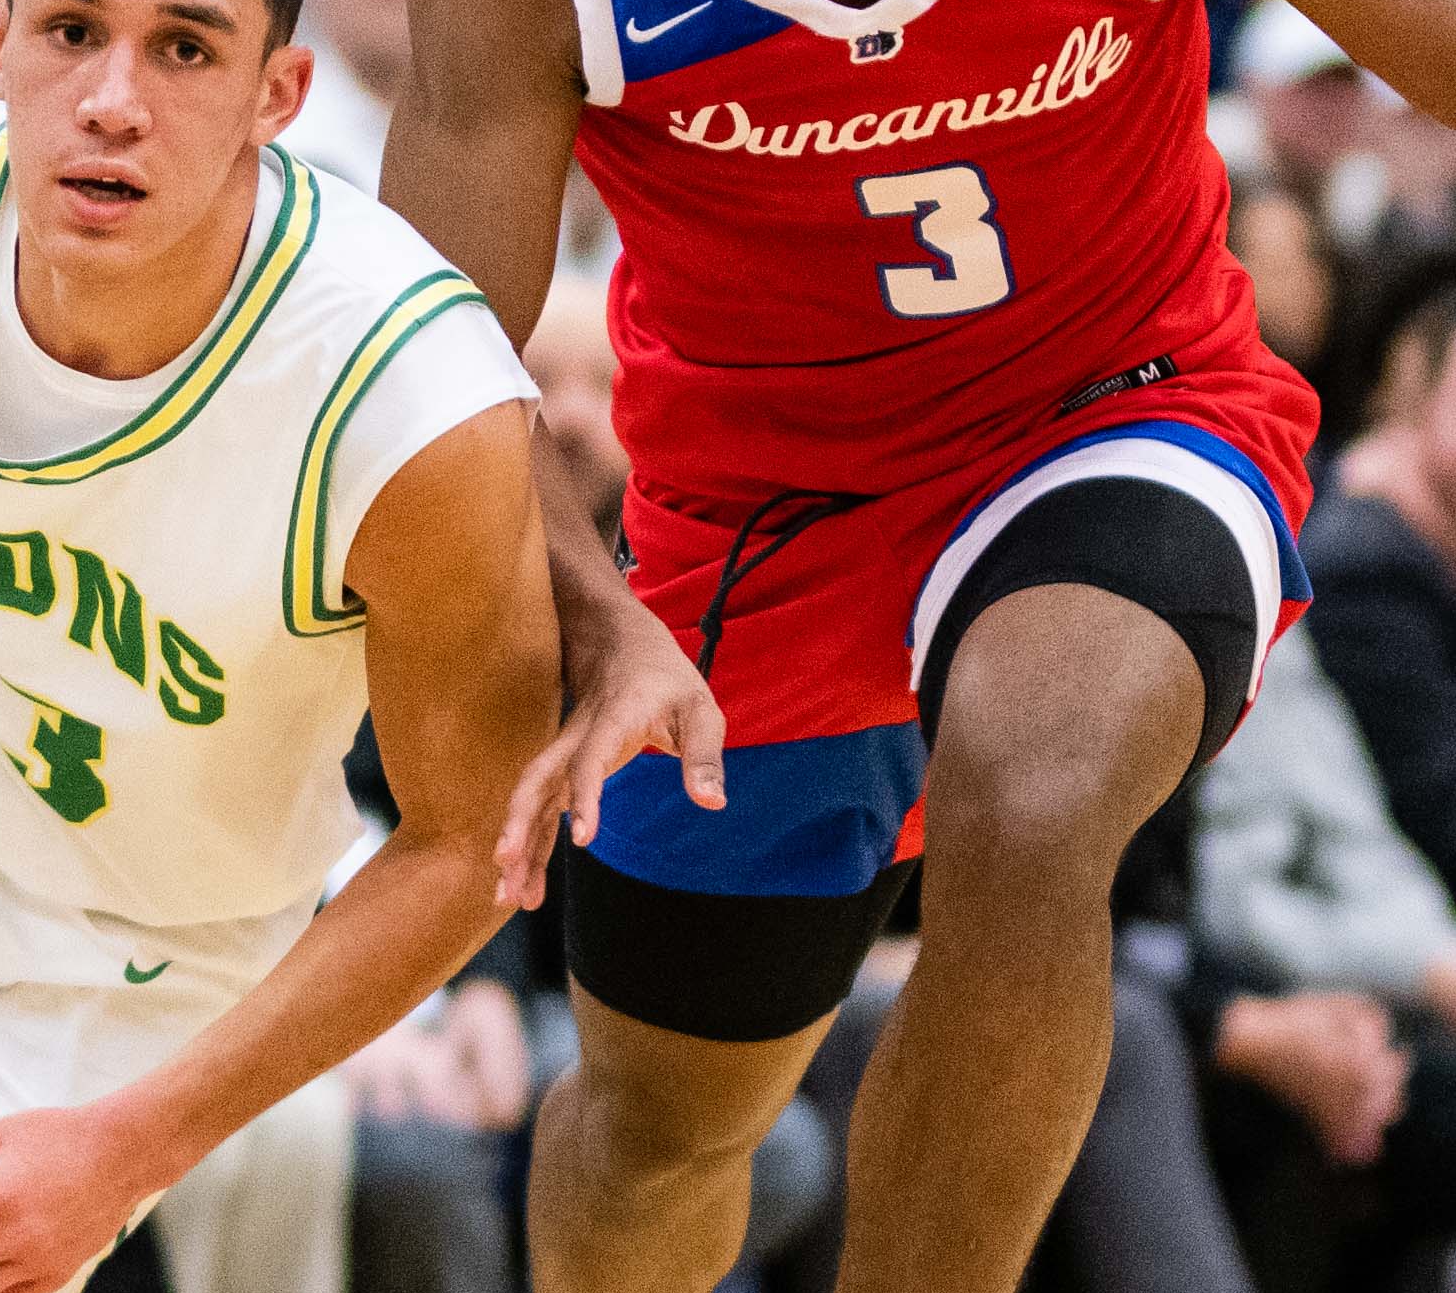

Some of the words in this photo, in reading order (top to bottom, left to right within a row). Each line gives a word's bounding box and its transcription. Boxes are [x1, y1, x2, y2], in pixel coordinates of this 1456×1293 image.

[669, 17, 1132, 156] Duncanville
[853, 159, 1016, 321] 3
[1138, 362, 1161, 385] M
